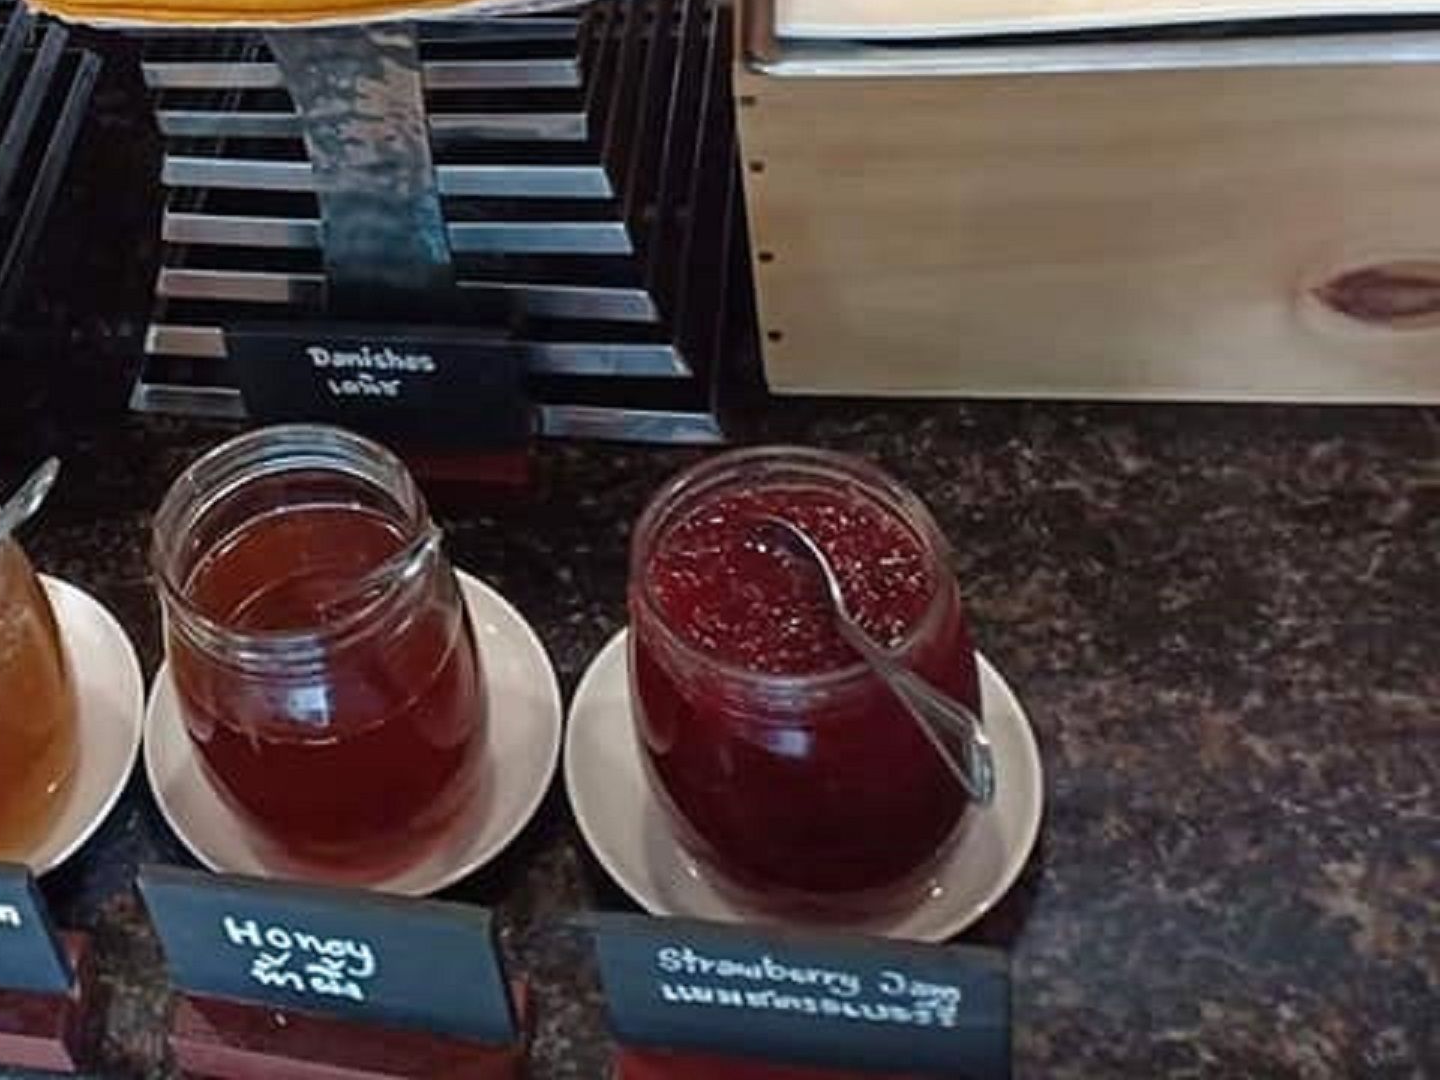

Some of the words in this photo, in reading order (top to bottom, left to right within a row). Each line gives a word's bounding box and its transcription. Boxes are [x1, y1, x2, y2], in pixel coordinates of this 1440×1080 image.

[223, 916, 377, 977] Honey
[657, 946, 861, 996] Strawberry
[879, 970, 961, 1002] Jam
